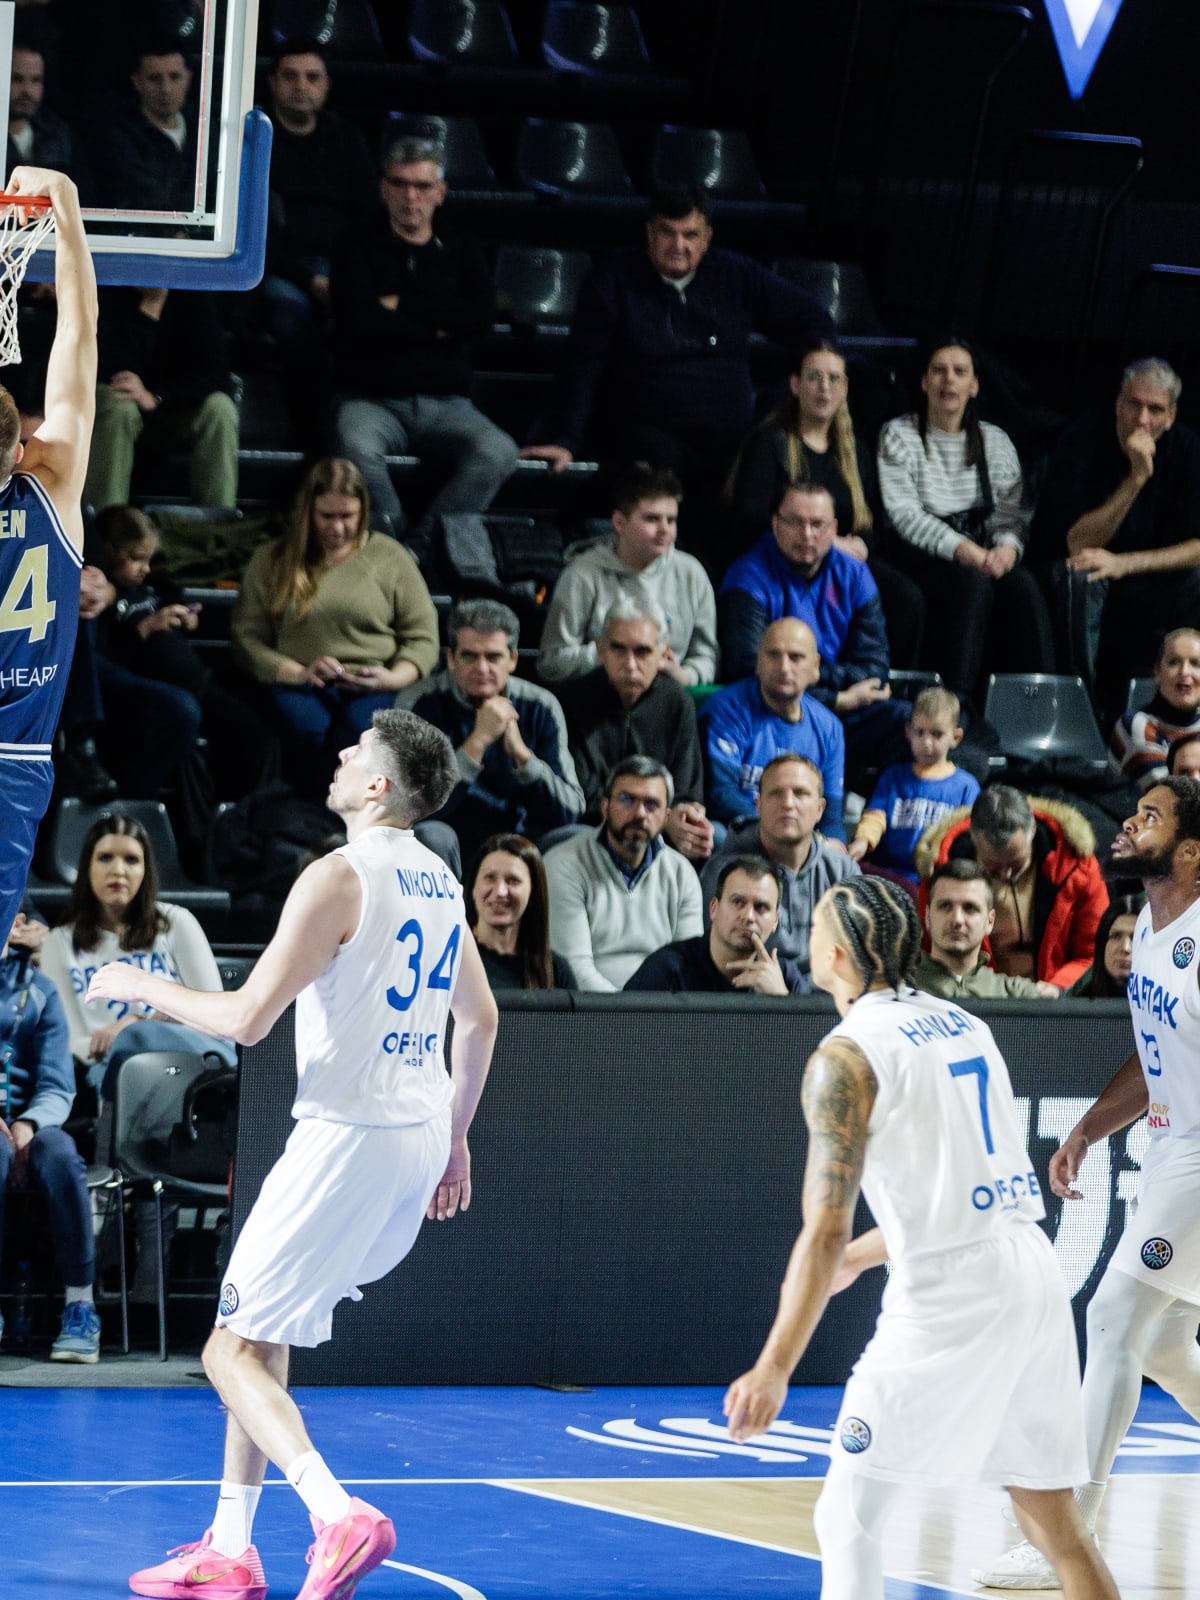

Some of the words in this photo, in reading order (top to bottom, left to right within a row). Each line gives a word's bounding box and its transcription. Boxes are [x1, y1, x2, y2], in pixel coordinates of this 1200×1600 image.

[396, 865, 454, 899] NIKOLIĆ
[386, 918, 461, 1012] 34
[1127, 971, 1179, 1030] PARTAK
[947, 1055, 995, 1155] 7
